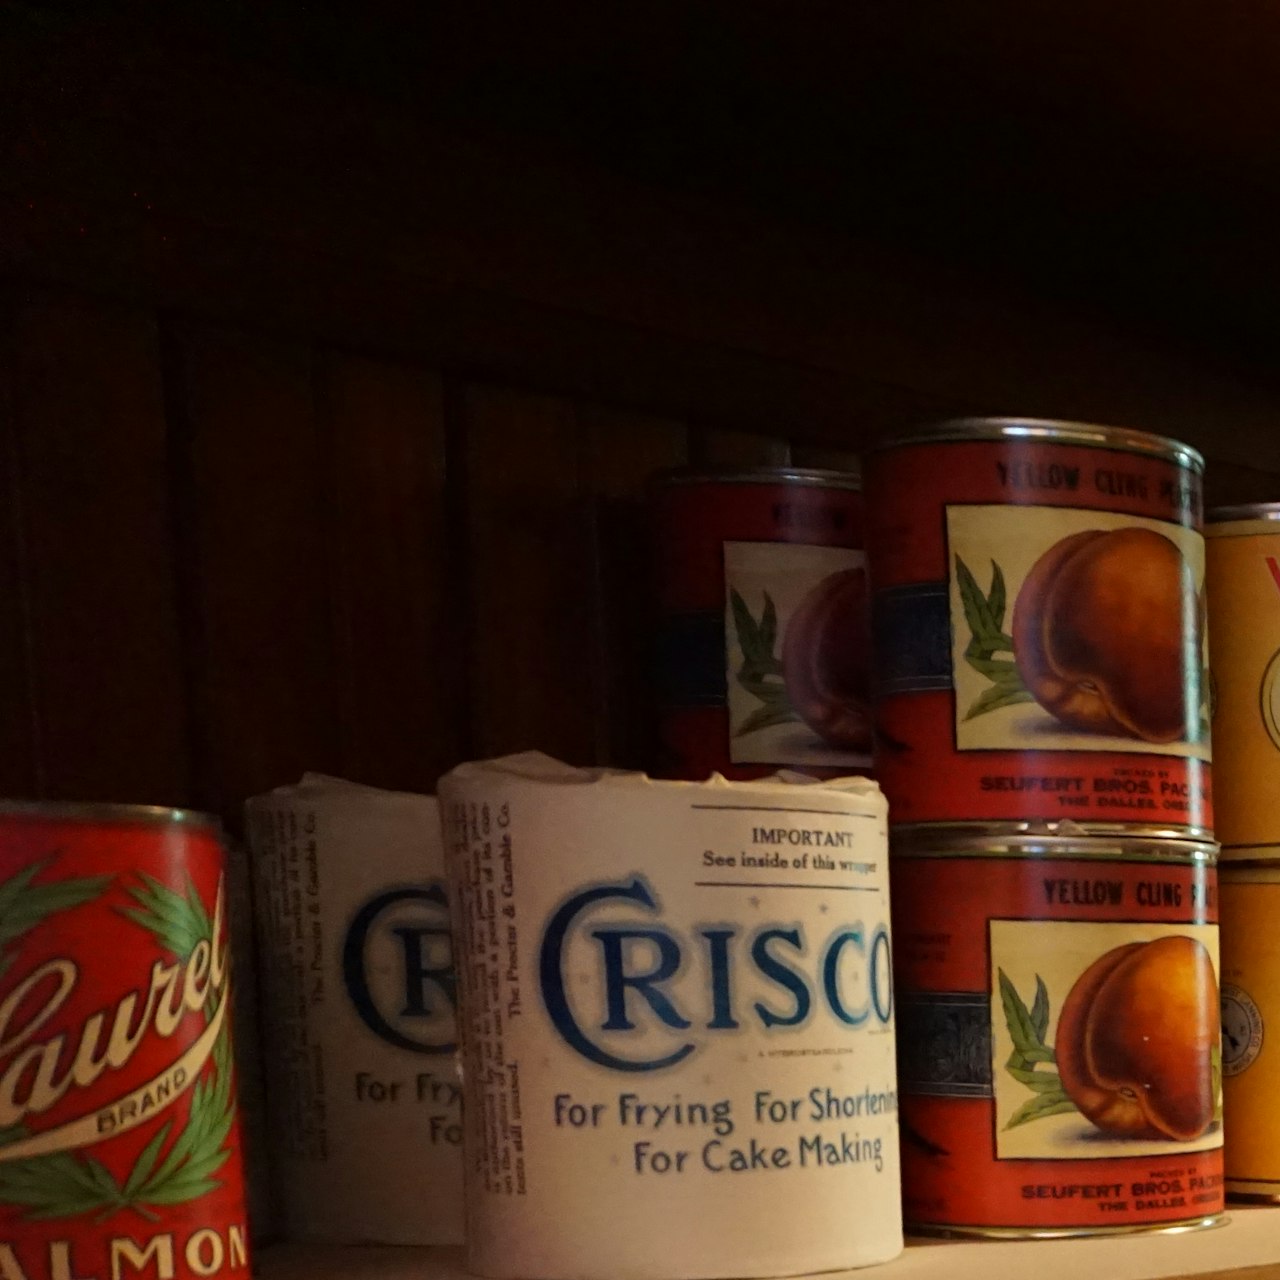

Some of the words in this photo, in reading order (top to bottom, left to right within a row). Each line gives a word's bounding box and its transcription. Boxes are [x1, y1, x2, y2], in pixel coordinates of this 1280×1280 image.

[980, 776, 1084, 792] SEUFERT
[751, 827, 853, 848] IMPORTANT
[498, 834, 514, 898] Gamble
[703, 850, 737, 867] See
[741, 851, 789, 869] inside
[792, 853, 809, 870] of
[812, 855, 836, 871] this
[1044, 879, 1124, 907] YELLOW
[1137, 881, 1182, 907] CLING
[502, 904, 516, 919] &
[505, 925, 520, 982] Procter
[540, 879, 892, 1072] CRISCO
[507, 987, 521, 1018] The
[96, 1066, 188, 1134] BRAND
[355, 1072, 400, 1101] For
[555, 1093, 605, 1128] For
[618, 1093, 735, 1136] Frying
[755, 1090, 808, 1123] For
[634, 1142, 689, 1174] For
[702, 1138, 791, 1173] Cake
[799, 1133, 883, 1174] Making
[1021, 1183, 1123, 1199] SEUFERT
